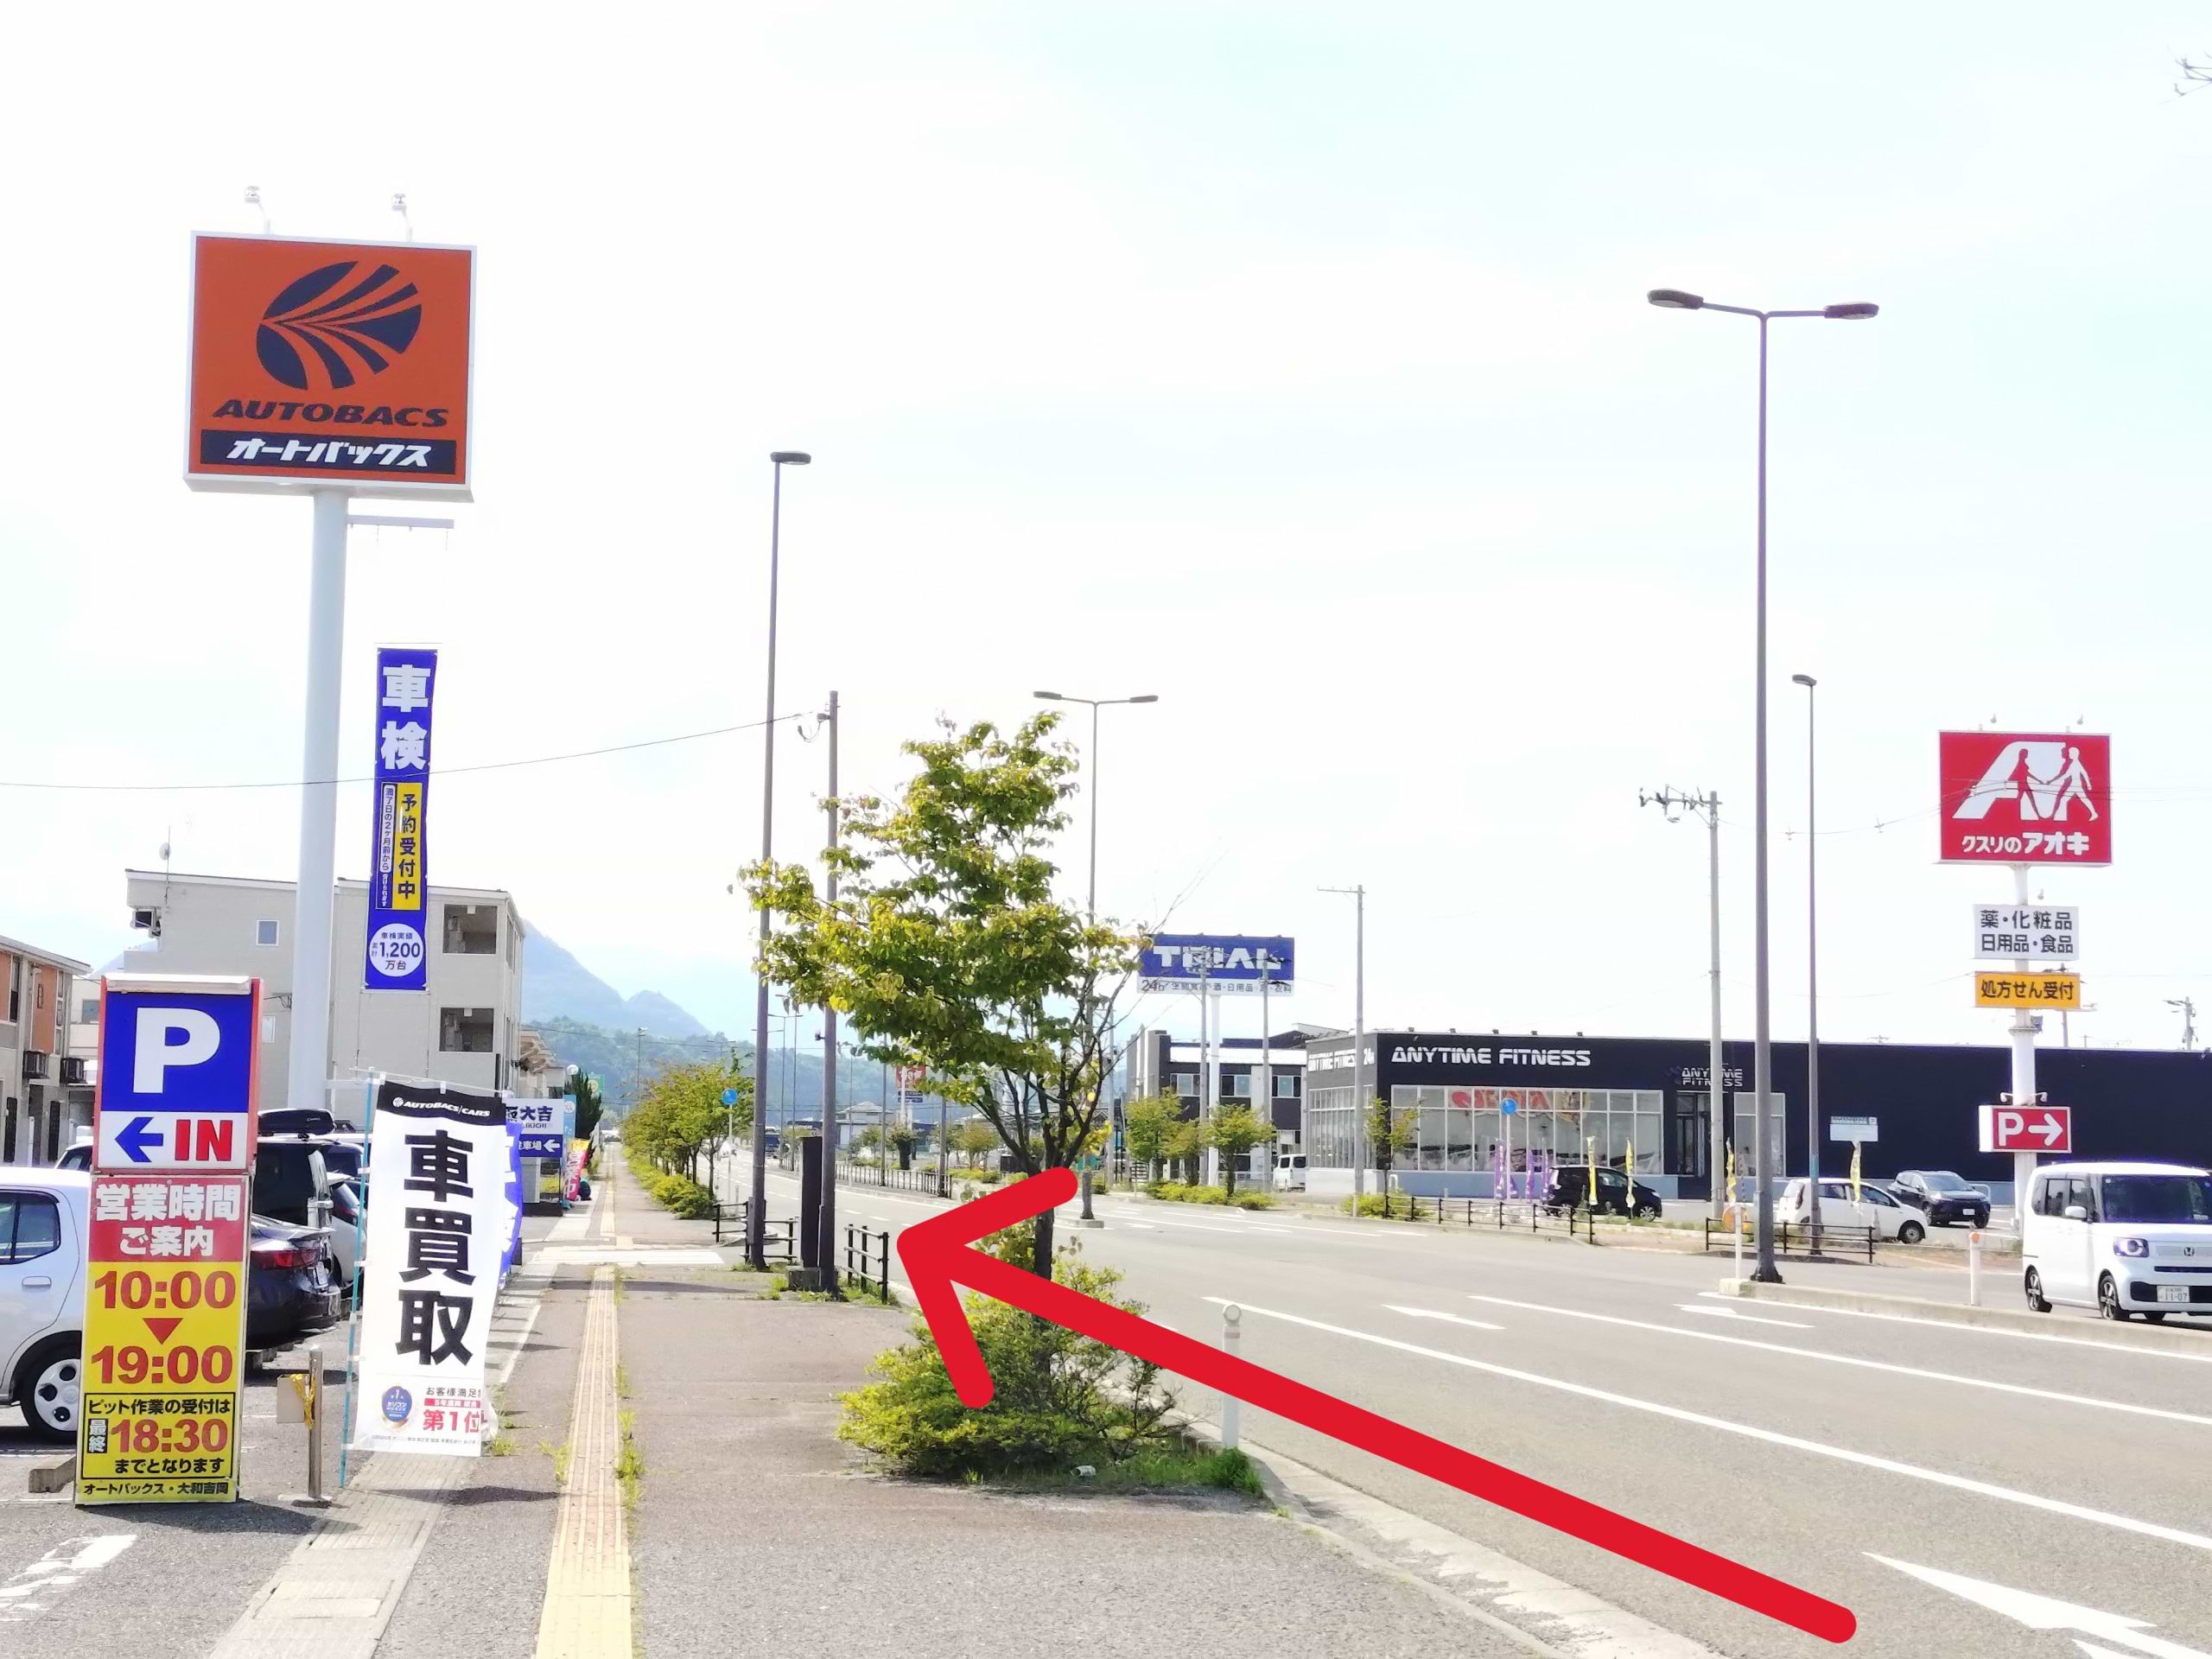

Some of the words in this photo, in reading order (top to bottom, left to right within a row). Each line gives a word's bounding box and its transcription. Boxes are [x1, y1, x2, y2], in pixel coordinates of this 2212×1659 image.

[213, 399, 449, 428] AUTOBACS
[226, 438, 431, 467] オートバックス
[380, 664, 431, 770] 車検
[397, 793, 417, 899] 予約受付中
[1961, 831, 2089, 855] クスリのアオキ
[1980, 910, 2073, 931] 薬・化粧品
[379, 942, 421, 958] 1,200
[1980, 933, 2074, 954] 日用品・食品
[385, 960, 407, 970] 万台
[1980, 980, 2075, 1001] 処方せん受付
[133, 1007, 221, 1094] P
[1391, 1046, 1491, 1065] ANYTIME
[1498, 1047, 1592, 1066] FITNESS
[1681, 1067, 1743, 1078] ANYME
[1682, 1077, 1744, 1087] FITNSS
[175, 1119, 233, 1161] IN
[1998, 1111, 2024, 1147] P
[95, 1183, 242, 1222] 営業時間
[119, 1226, 214, 1257] ご案内
[395, 1129, 476, 1366] 車買取
[94, 1270, 236, 1309] 10:00
[91, 1345, 232, 1384] 19:00
[88, 1399, 232, 1415] ピット作業の受付は
[423, 1408, 481, 1433] 第1位
[88, 1419, 107, 1453] 最終
[111, 1419, 228, 1453] 18:30
[115, 1458, 225, 1474] までとなります
[84, 1482, 229, 1496] オートバックス・大和吉岡
